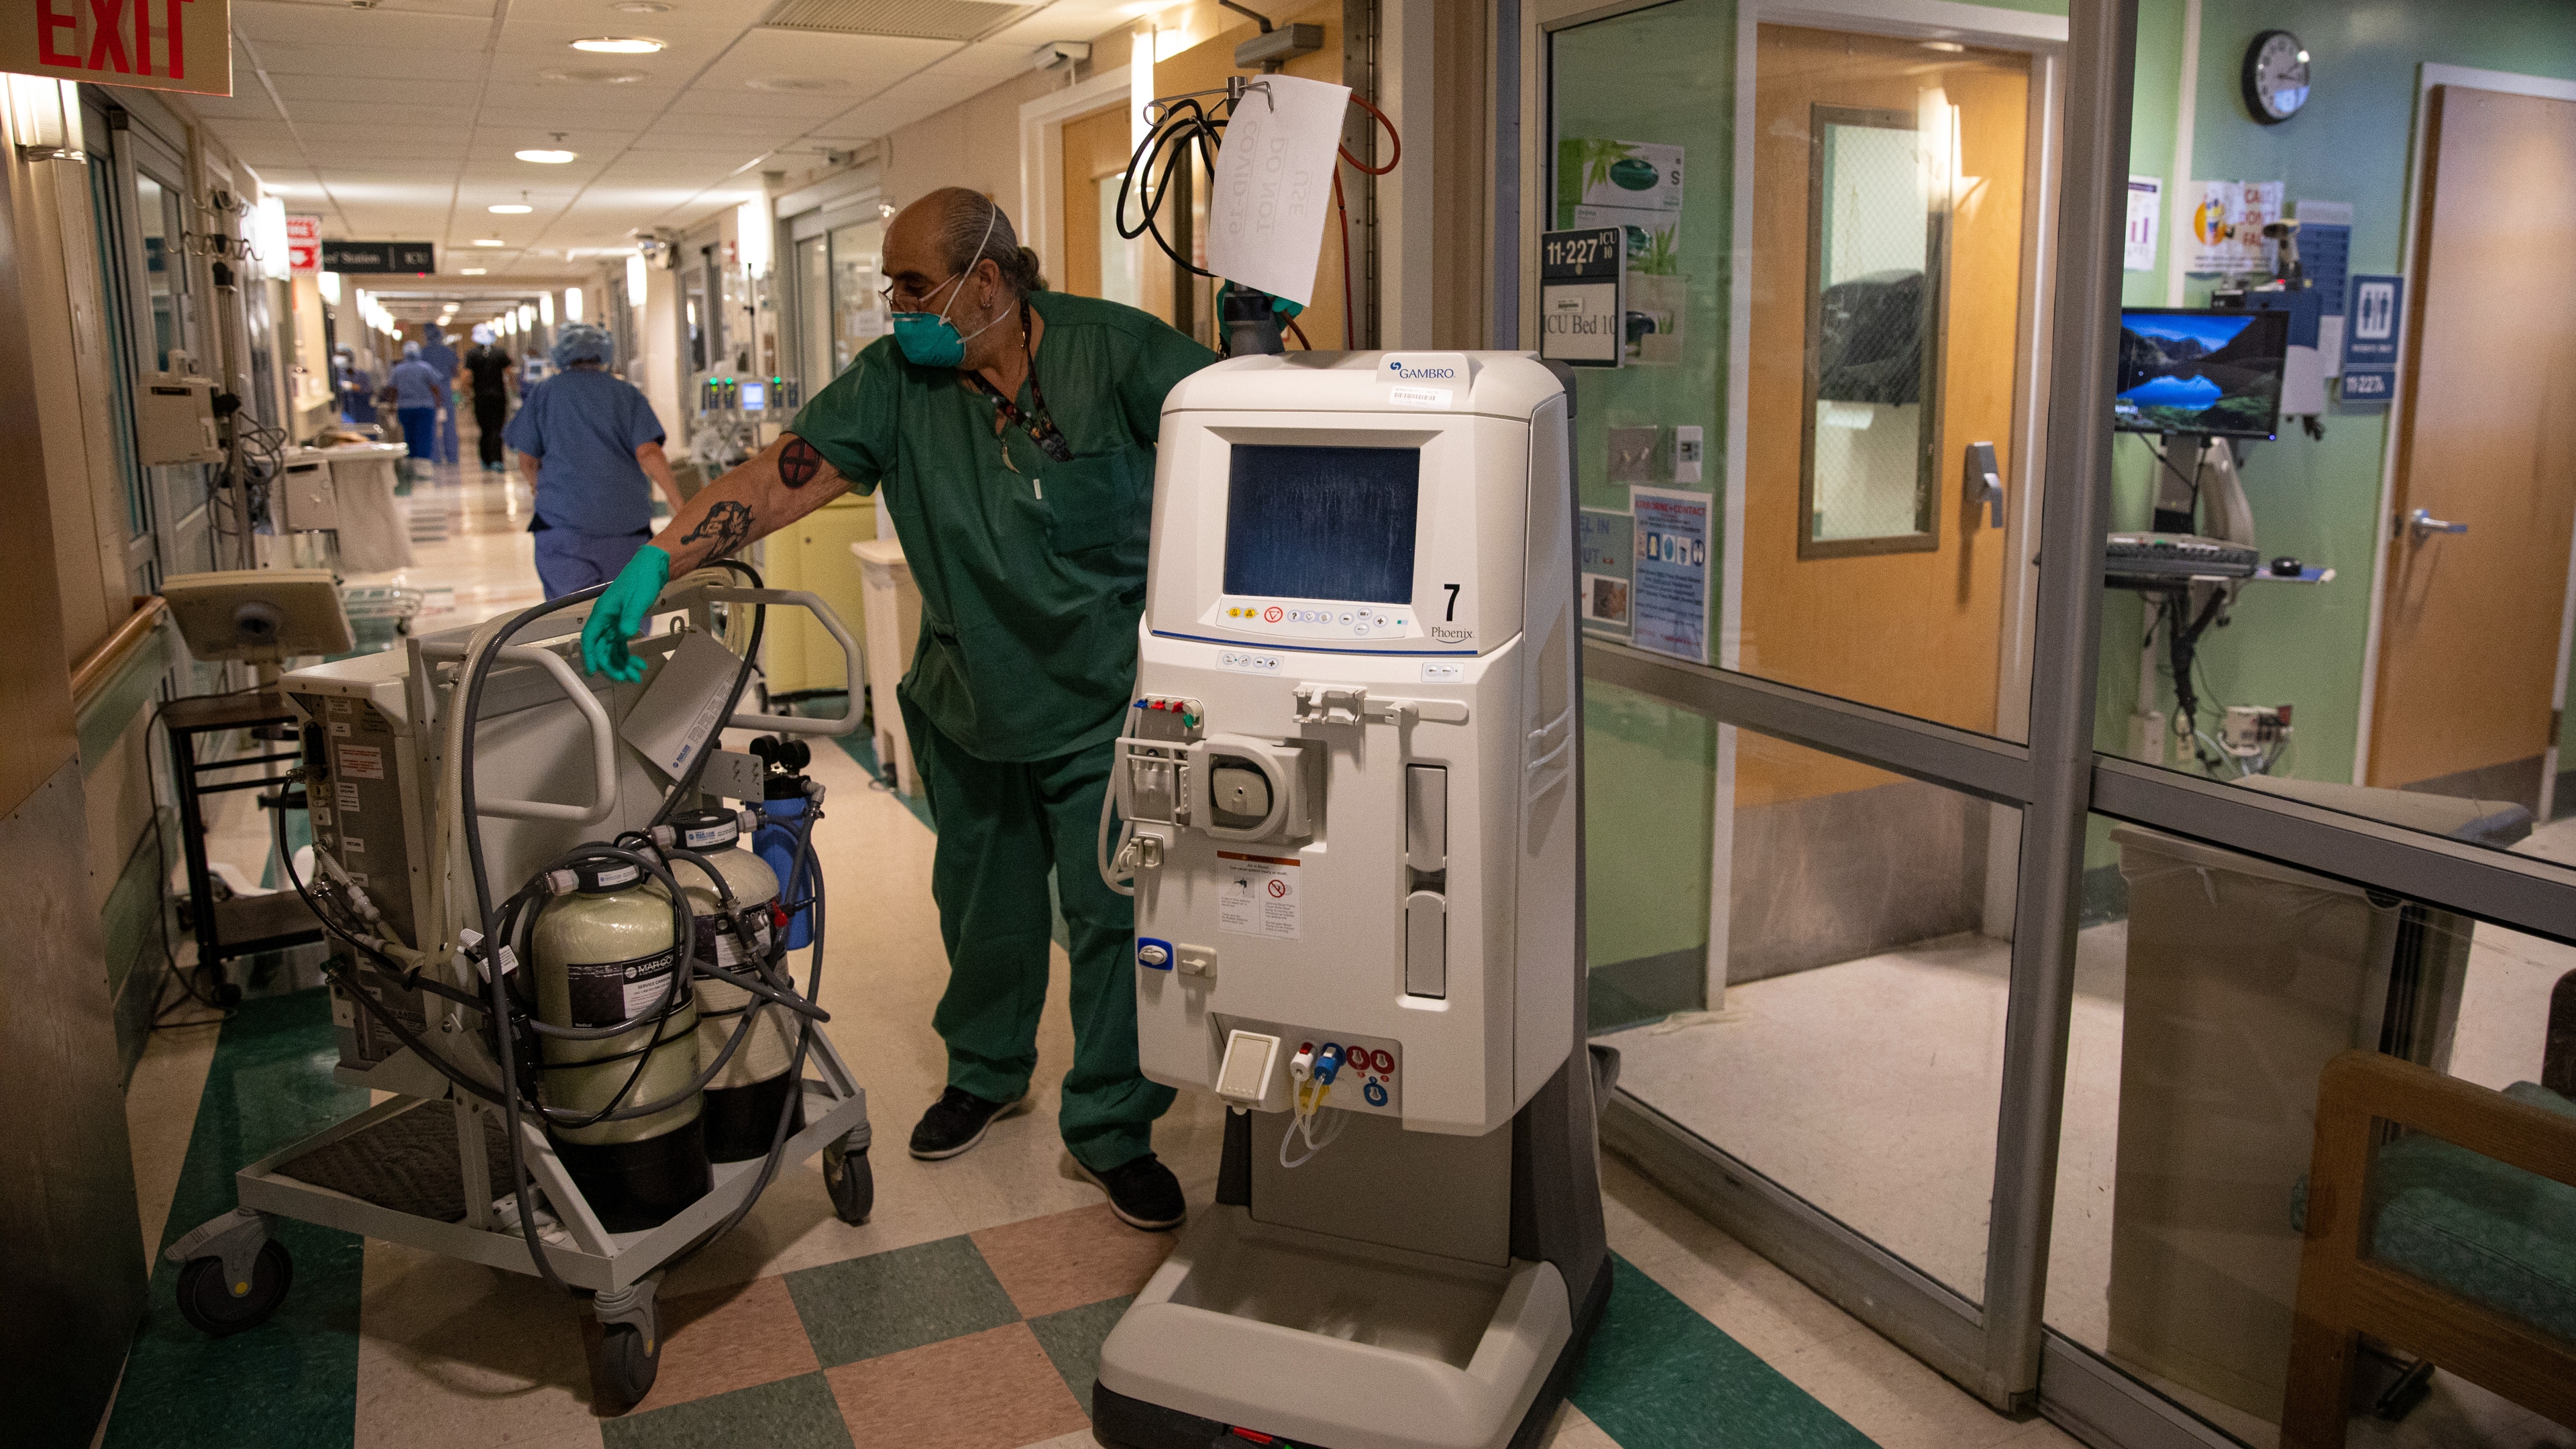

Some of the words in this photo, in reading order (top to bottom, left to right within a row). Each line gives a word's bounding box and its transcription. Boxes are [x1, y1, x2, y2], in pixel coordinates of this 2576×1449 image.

[36, 0, 195, 79] EXIT
[1599, 231, 1617, 246] ICU
[1547, 239, 1598, 265] 11-227
[1604, 246, 1613, 259] 10
[1572, 315, 1597, 334] Bed
[1399, 368, 1454, 379] GAMBRO
[1444, 583, 1460, 622] 7
[1431, 627, 1473, 639] Phoenix
[638, 981, 655, 989] SERVICE
